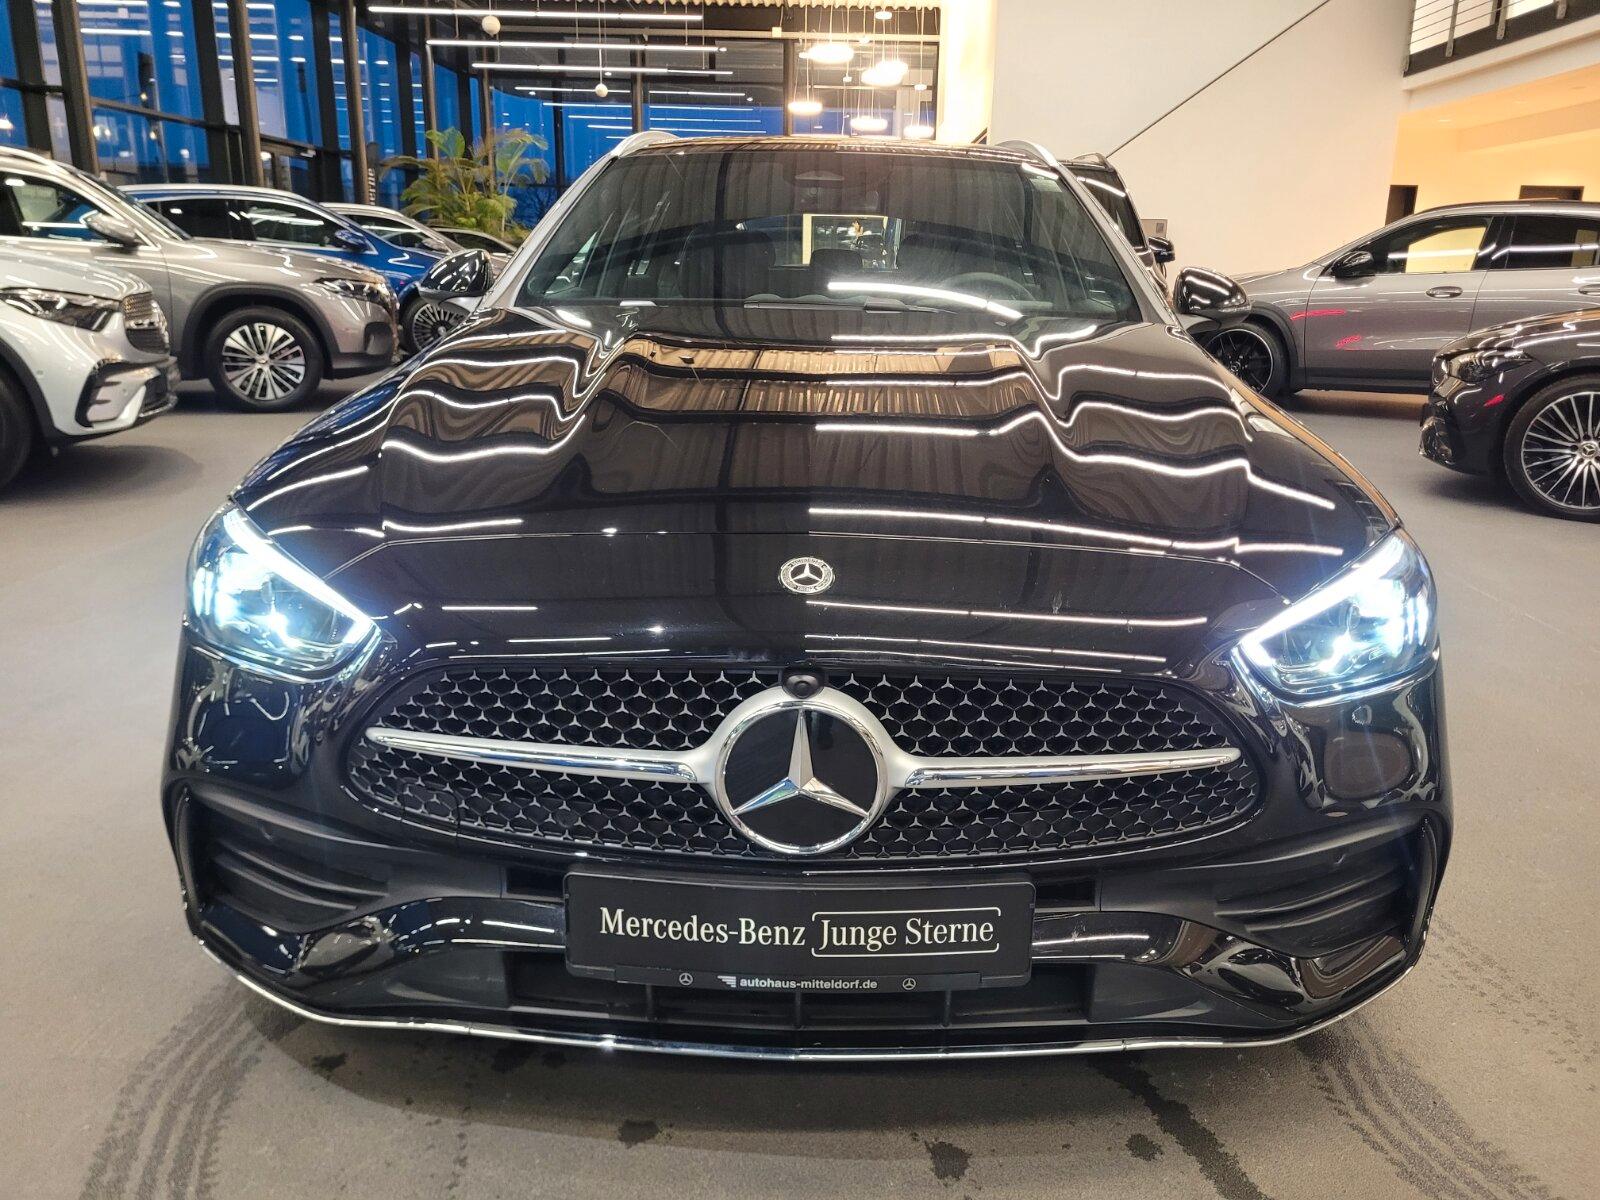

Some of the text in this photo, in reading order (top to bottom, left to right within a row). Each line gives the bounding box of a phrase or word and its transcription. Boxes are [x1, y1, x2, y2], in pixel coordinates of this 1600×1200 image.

[599, 906, 995, 952] Mercedes-Benz Junge Sterne
[739, 977, 878, 991] autohaus-mitteldorf.de
